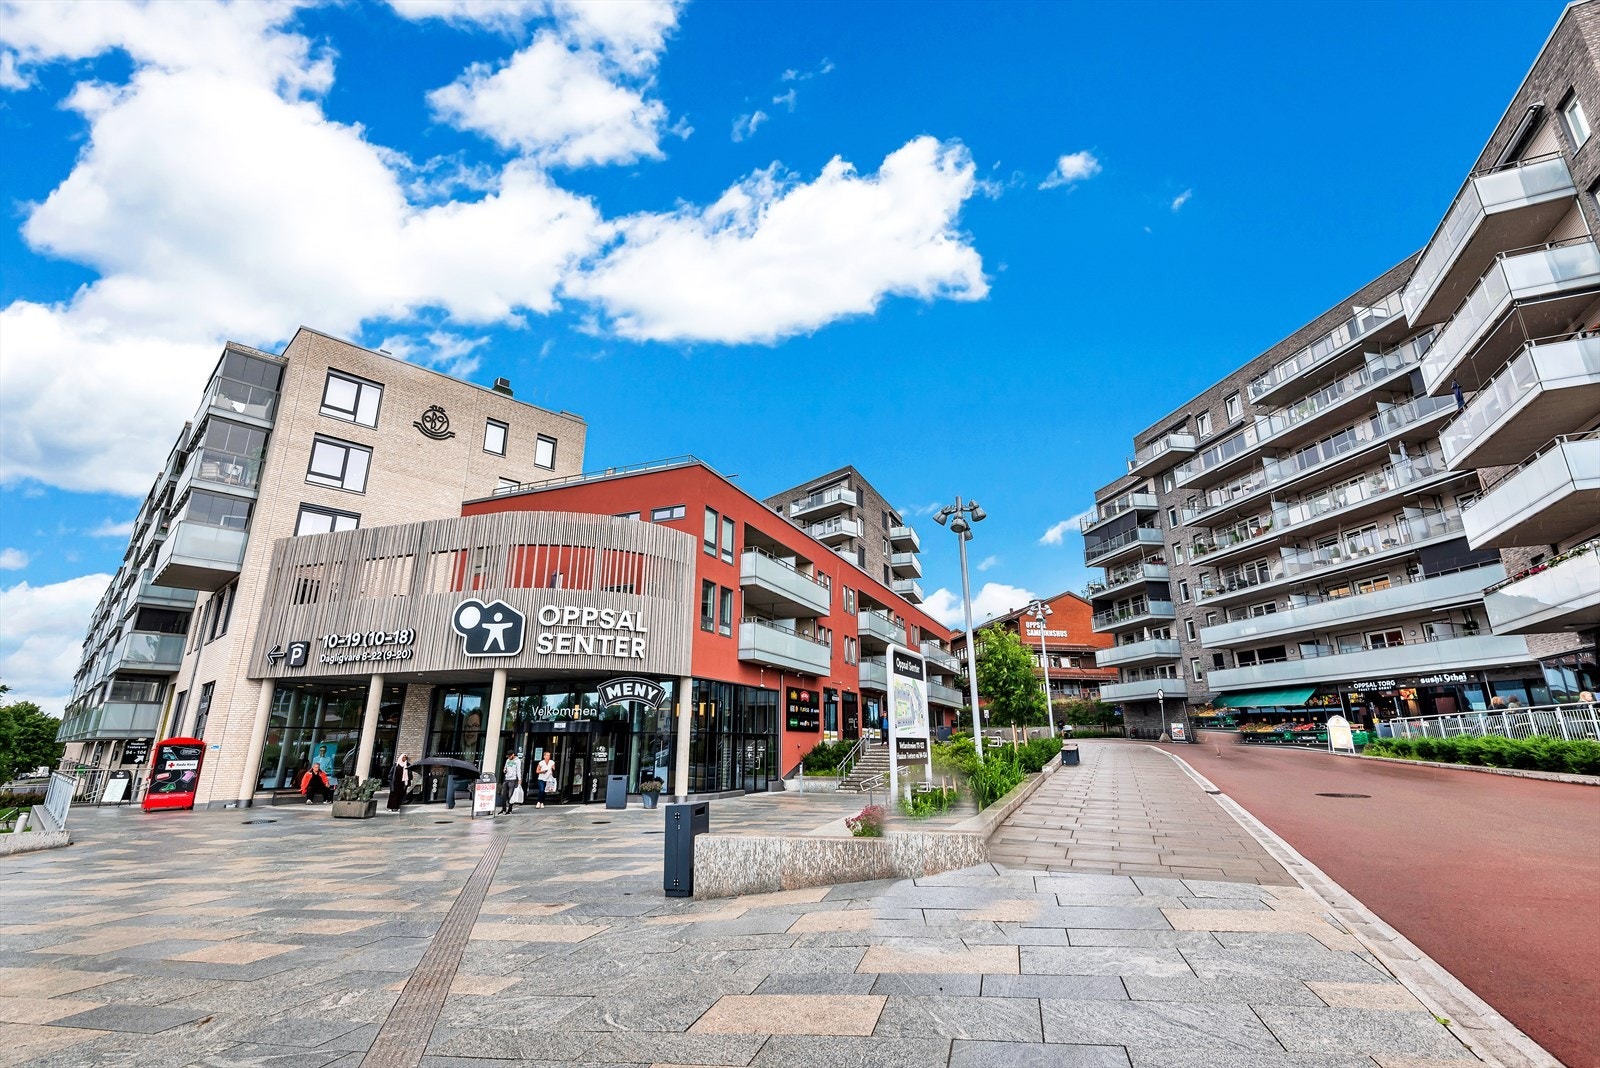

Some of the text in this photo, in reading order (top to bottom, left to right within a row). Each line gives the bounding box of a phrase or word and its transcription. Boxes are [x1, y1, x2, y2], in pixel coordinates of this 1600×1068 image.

[538, 604, 648, 633] OPPSAL
[1025, 621, 1047, 629] OPPSL
[323, 628, 415, 648] 10-19 (10-18)
[535, 632, 646, 659] SENTER
[320, 653, 360, 665] Dagligvare
[606, 682, 659, 700] MENY
[1353, 679, 1396, 689] OPPSAL TORG
[531, 705, 597, 717] Velkommen
